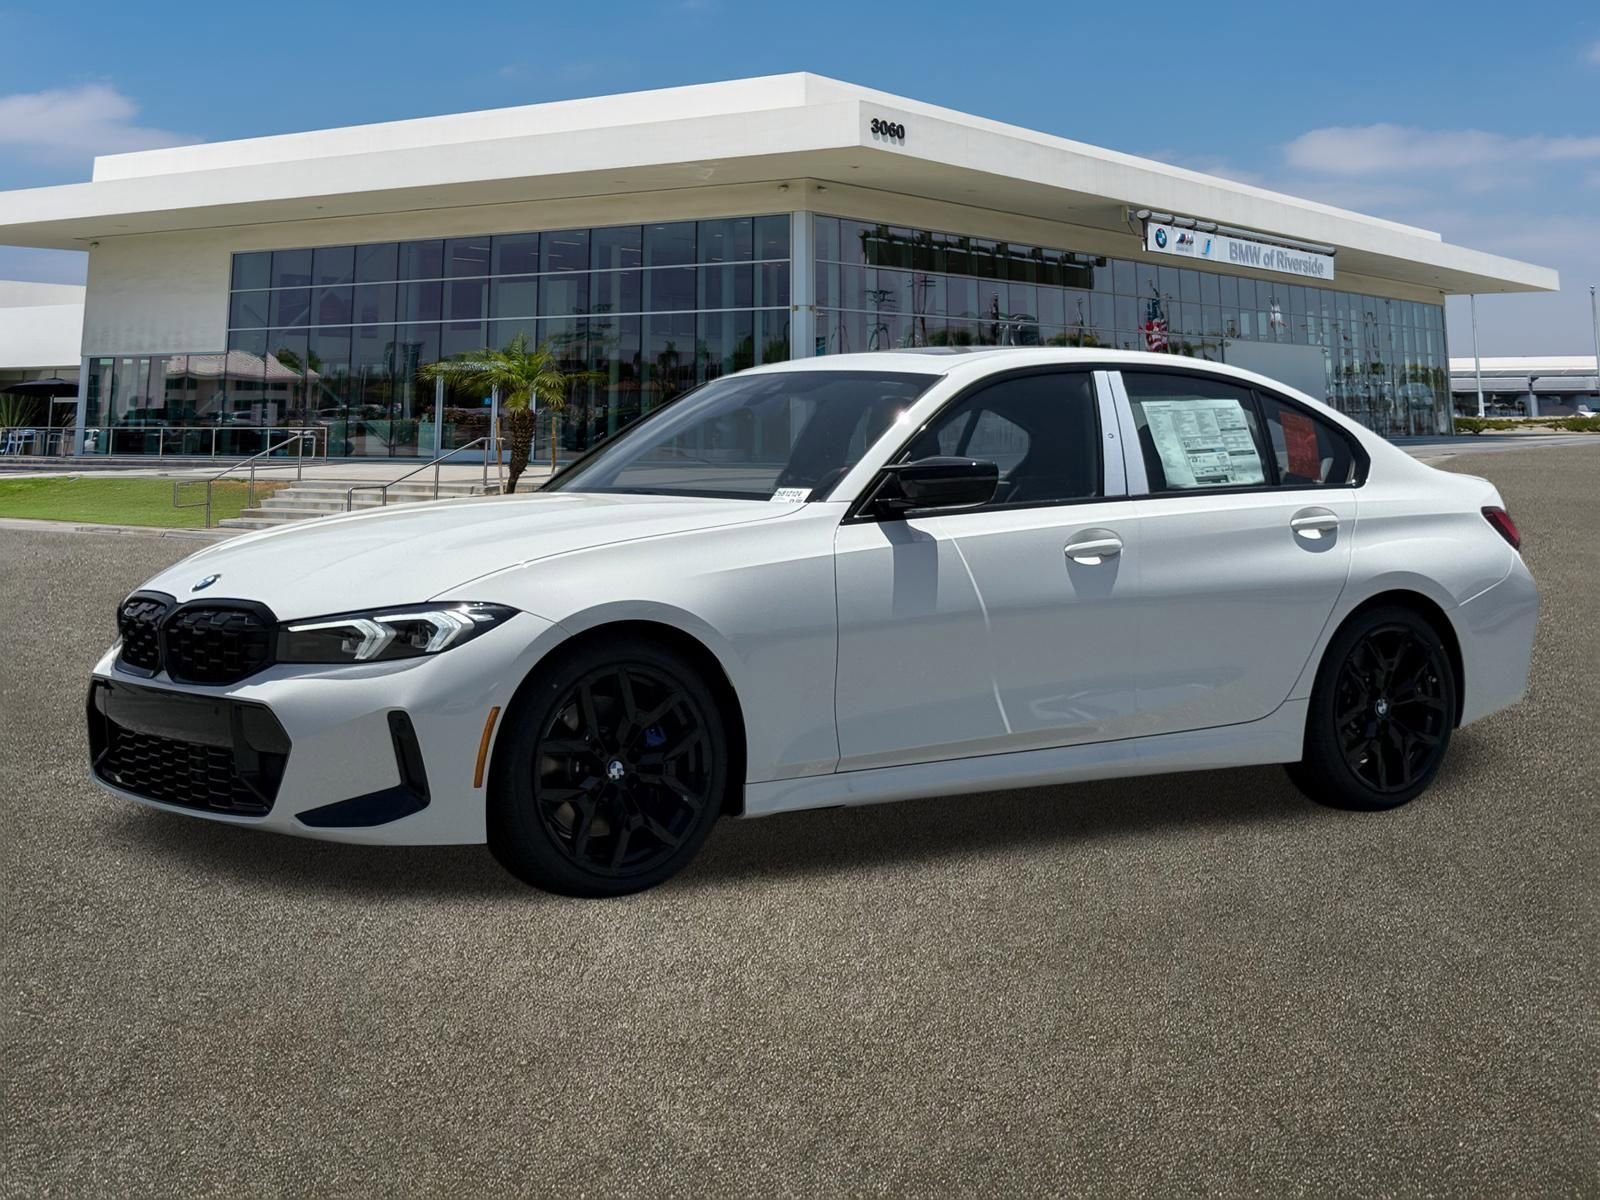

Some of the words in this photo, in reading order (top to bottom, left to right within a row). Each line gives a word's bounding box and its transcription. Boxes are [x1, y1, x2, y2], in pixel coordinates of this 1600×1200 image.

[871, 118, 905, 139] 3060
[1229, 242, 1261, 264] BMW
[1263, 249, 1275, 267] of
[1276, 251, 1324, 275] Riverside
